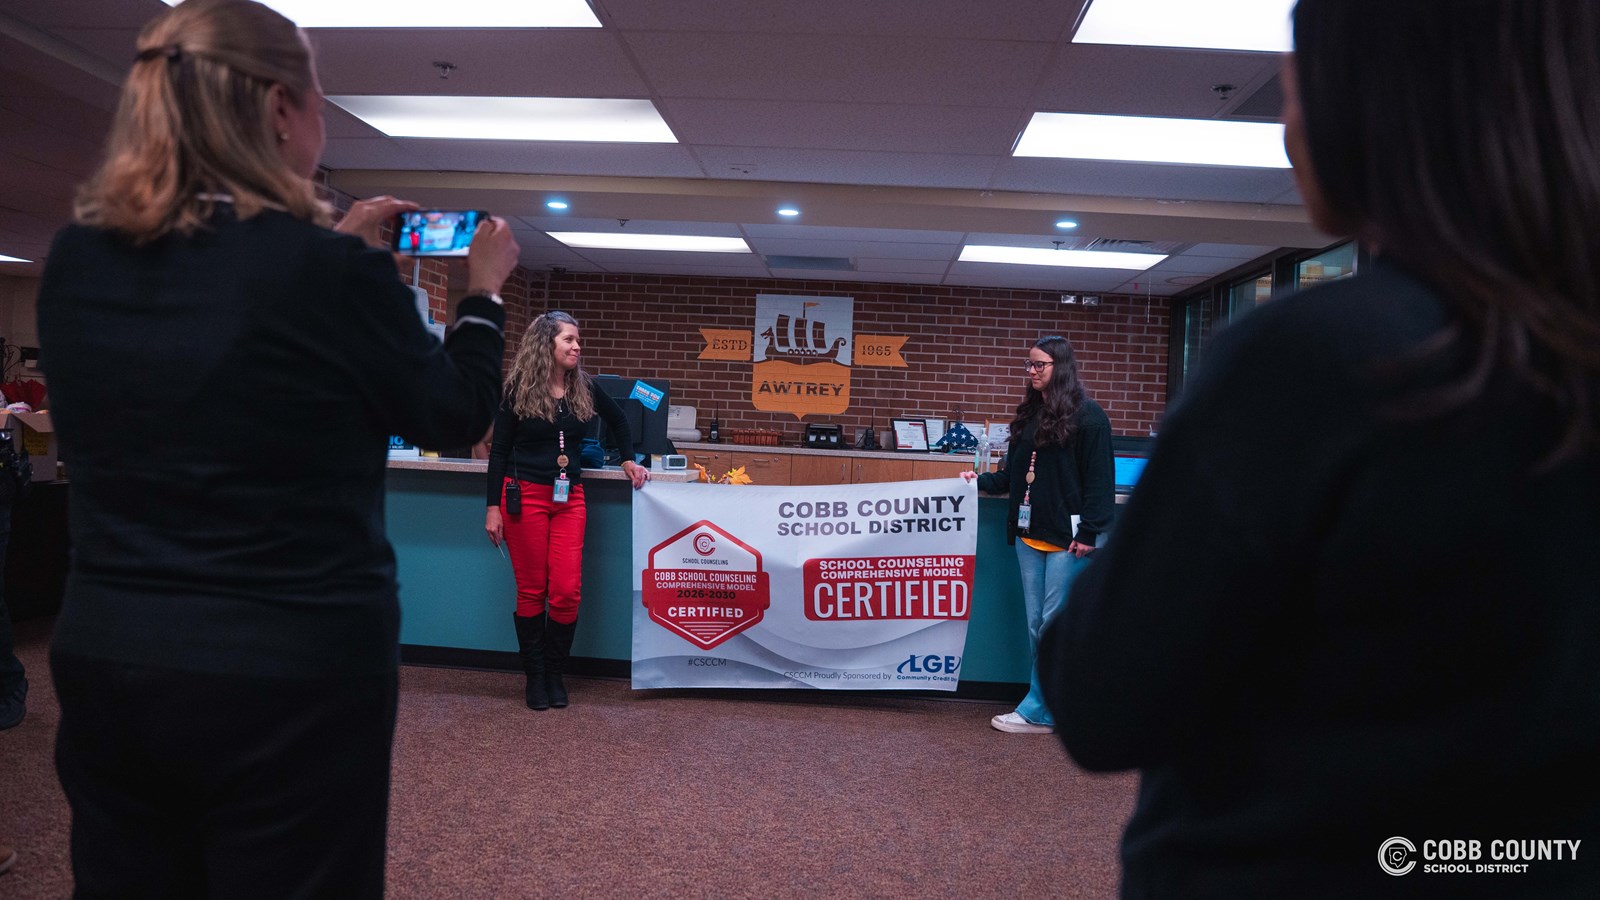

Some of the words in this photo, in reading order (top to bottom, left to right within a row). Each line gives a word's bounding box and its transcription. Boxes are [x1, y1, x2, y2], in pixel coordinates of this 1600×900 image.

[712, 338, 747, 350] ESTD
[862, 345, 891, 356] 1965
[758, 381, 844, 396] AWTREY
[778, 502, 848, 518] COBB
[857, 496, 965, 517] COUNTY
[777, 521, 861, 536] SCHOOL
[869, 518, 965, 534] DISTRICT
[820, 560, 873, 570] SCHOOL
[878, 558, 964, 568] COUNSELING
[654, 572, 676, 580] COBB
[678, 572, 707, 581] SCHOOL
[710, 573, 756, 583] COUNSELING
[821, 569, 920, 580] COMPREHENSIVE
[923, 568, 963, 577] MODEL
[677, 590, 736, 599] 2026-2030
[814, 580, 968, 618] CERTIFIED
[668, 607, 744, 618] CERTIFIED
[688, 658, 727, 667] #CSCCM
[909, 654, 956, 674] LGE
[813, 672, 840, 680] Proudly
[842, 672, 881, 681] Sponsored
[883, 673, 892, 681] by
